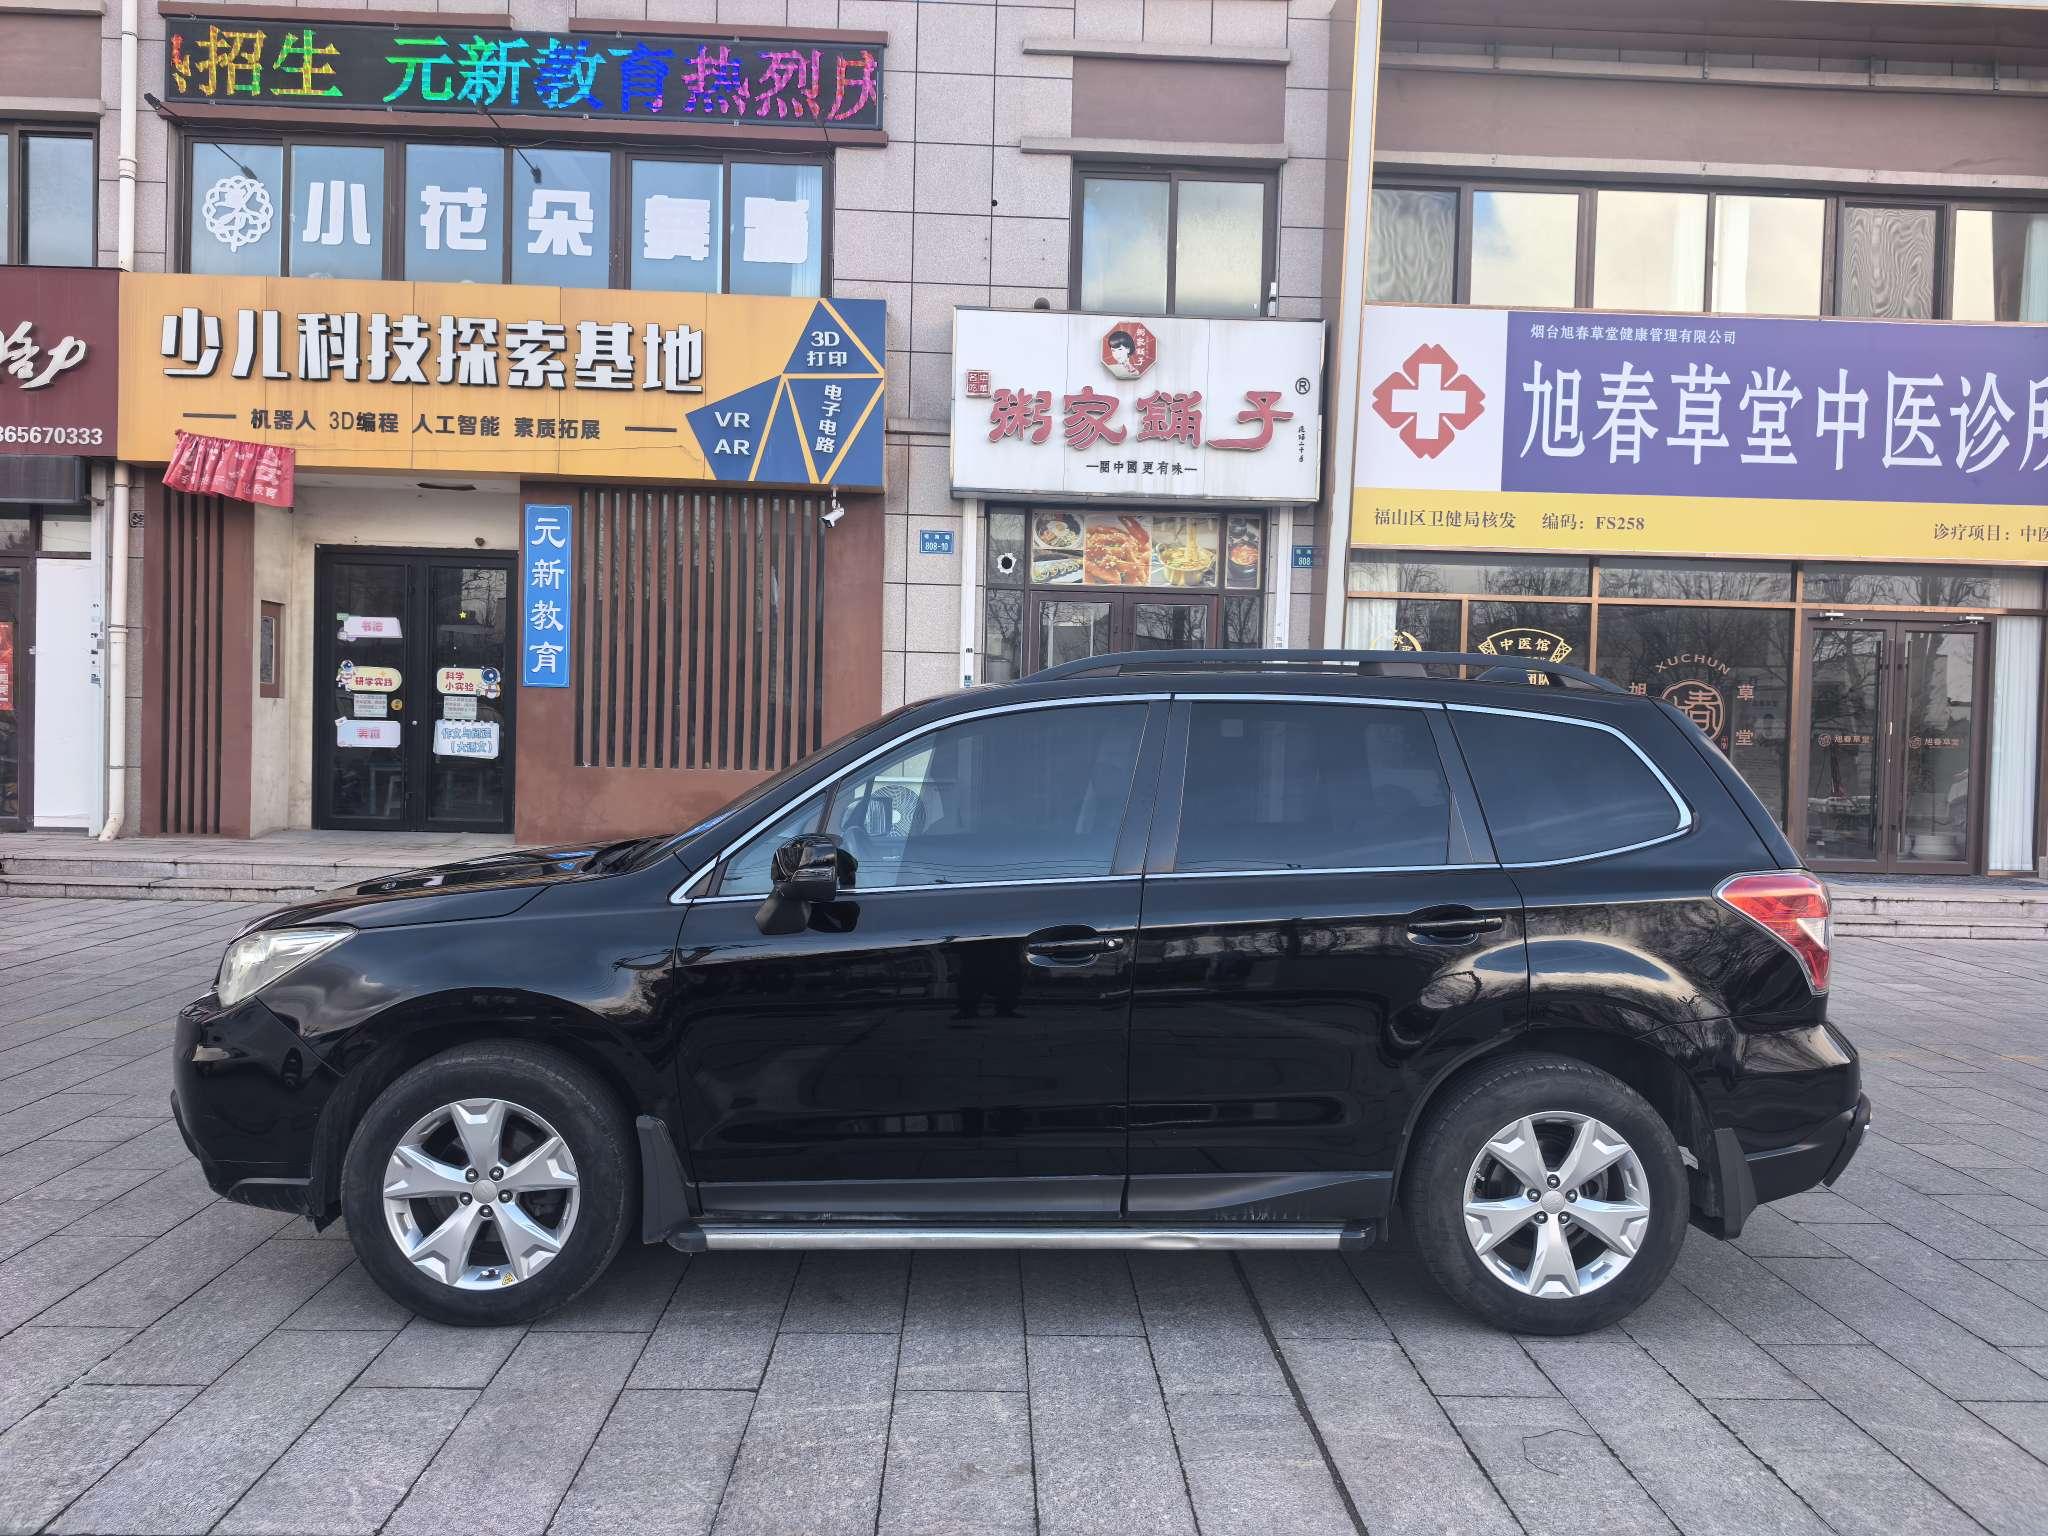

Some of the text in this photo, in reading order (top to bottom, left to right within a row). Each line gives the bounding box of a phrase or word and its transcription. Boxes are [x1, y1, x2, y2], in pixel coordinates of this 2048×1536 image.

[303, 181, 810, 264] 小花朵
[811, 331, 840, 346] 3D
[1530, 323, 1737, 345] 烟台旭春草堂健康管理有限公司
[161, 306, 705, 393] 少儿科技探索基地
[807, 351, 847, 367] 打印
[250, 408, 601, 440] 机器人 3D编程 人工智能 素质拓展
[714, 411, 750, 428] VR
[815, 384, 842, 454] 电子电路
[714, 439, 750, 456] AR
[1374, 507, 1516, 529] 福山区卫健局核发
[1595, 516, 1645, 530] FS258
[925, 542, 949, 551] 808-10
[529, 516, 567, 674] 元新教育
[1500, 638, 1551, 651] 中医馆
[1655, 653, 1731, 675] XUCHUN
[445, 682, 474, 692] 小实验
